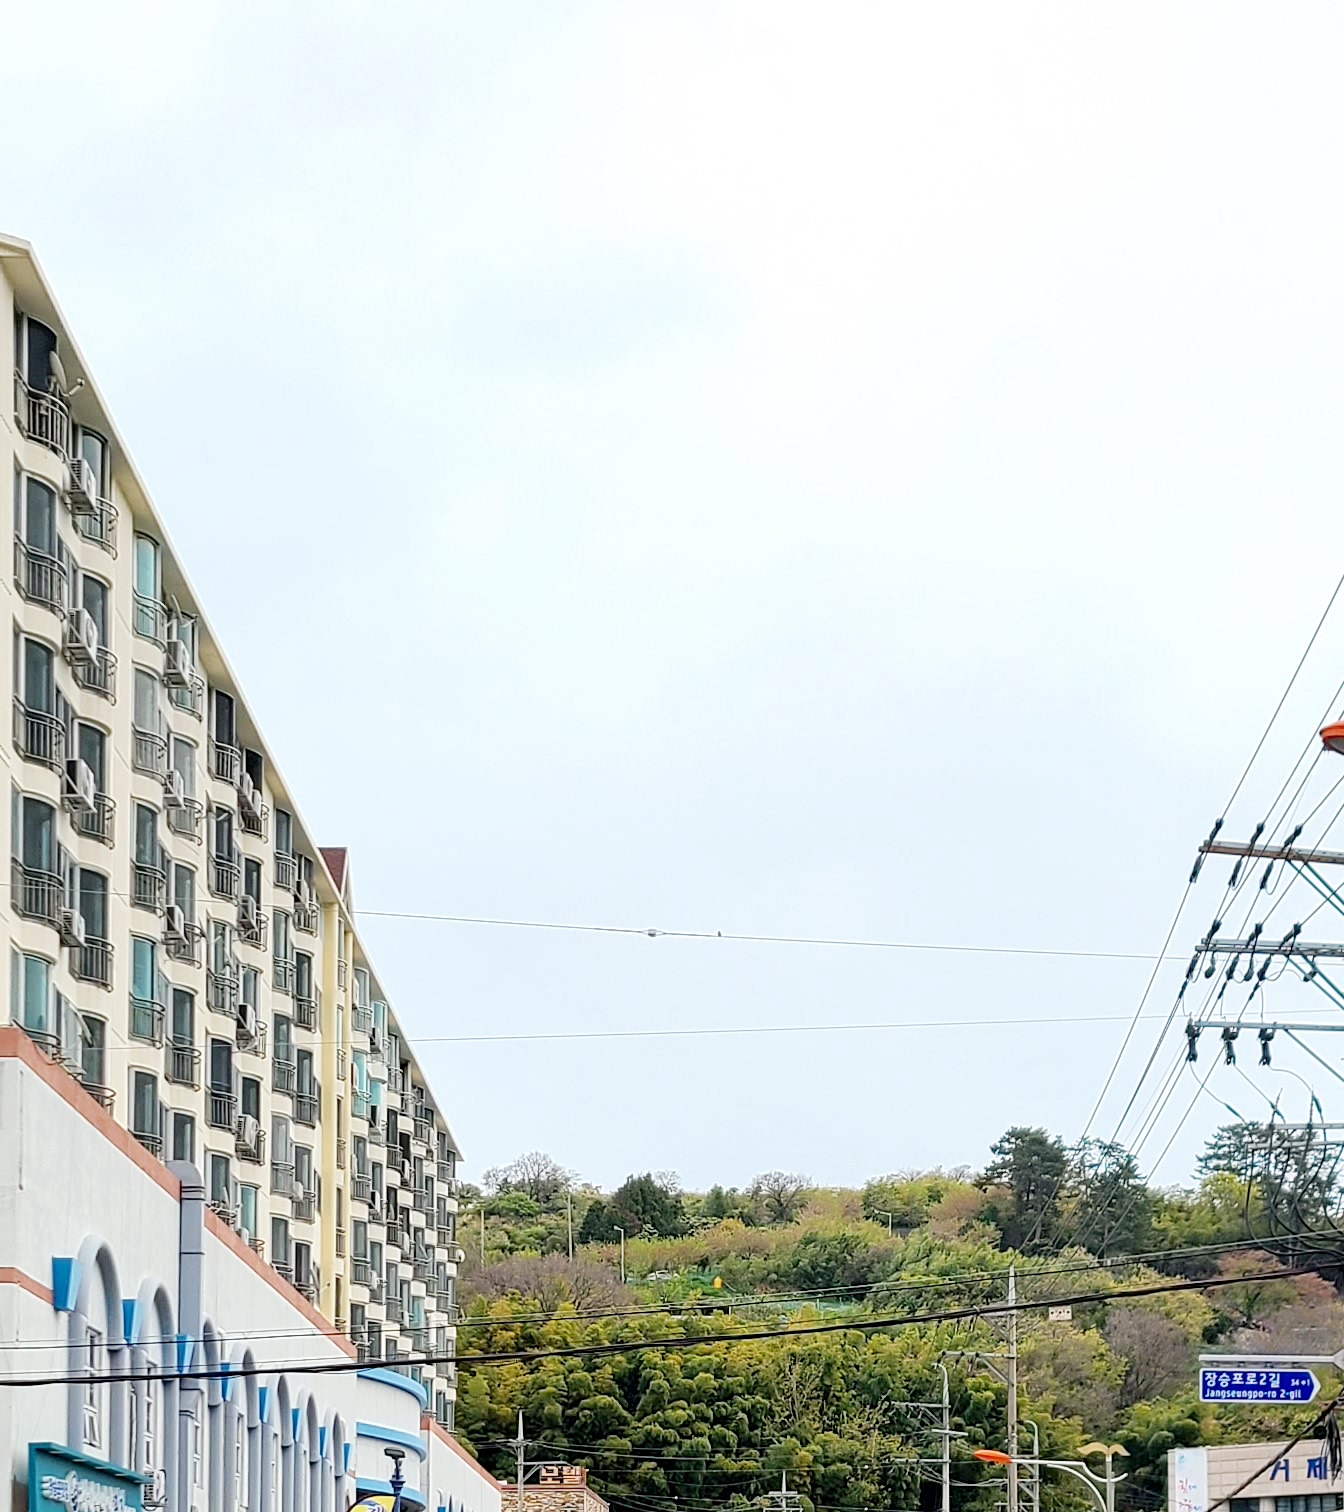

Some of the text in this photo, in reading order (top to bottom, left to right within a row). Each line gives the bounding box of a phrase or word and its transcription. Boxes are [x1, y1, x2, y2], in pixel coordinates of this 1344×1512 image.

[1204, 1372, 1281, 1388] 장승포로2길
[1204, 1388, 1302, 1400] Jangseungpo-ro 2-gil
